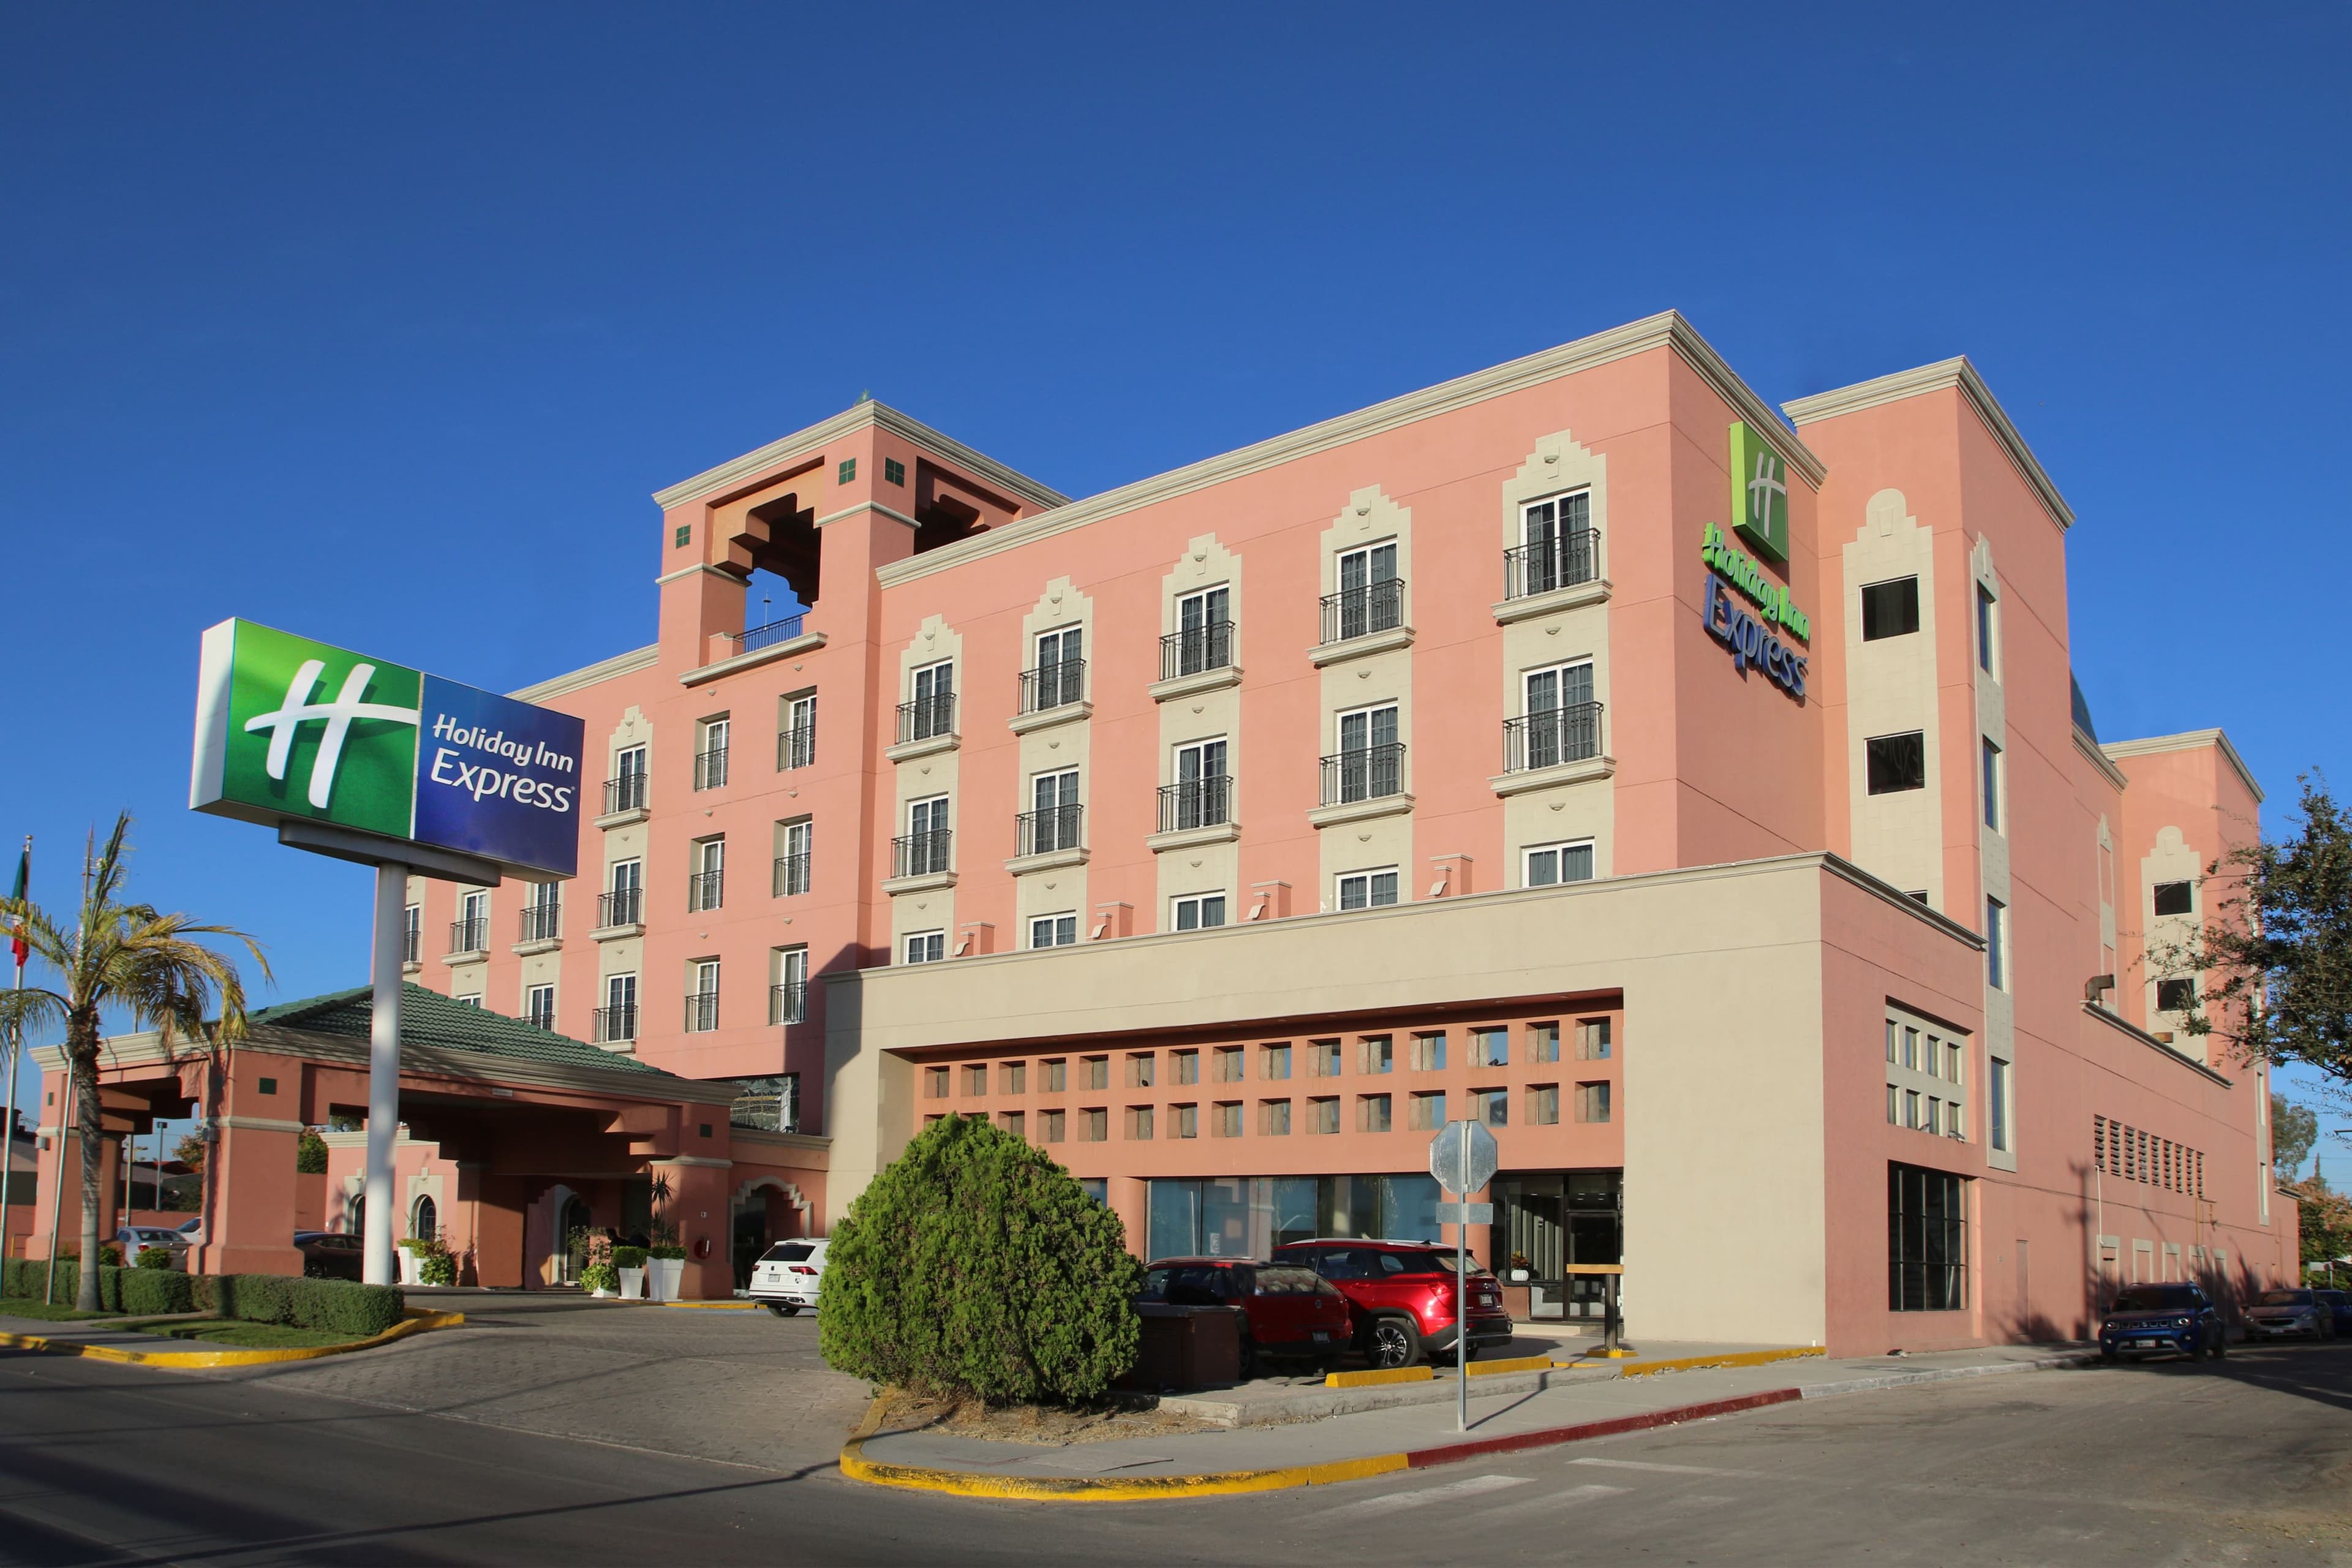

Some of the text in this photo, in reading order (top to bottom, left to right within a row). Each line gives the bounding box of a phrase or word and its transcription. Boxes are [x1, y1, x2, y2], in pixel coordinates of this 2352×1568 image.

[1702, 521, 1810, 641] Holiday Inn
[1703, 573, 1806, 696] Express
[431, 747, 571, 813] Express
[432, 714, 573, 773] Holiday Inn
